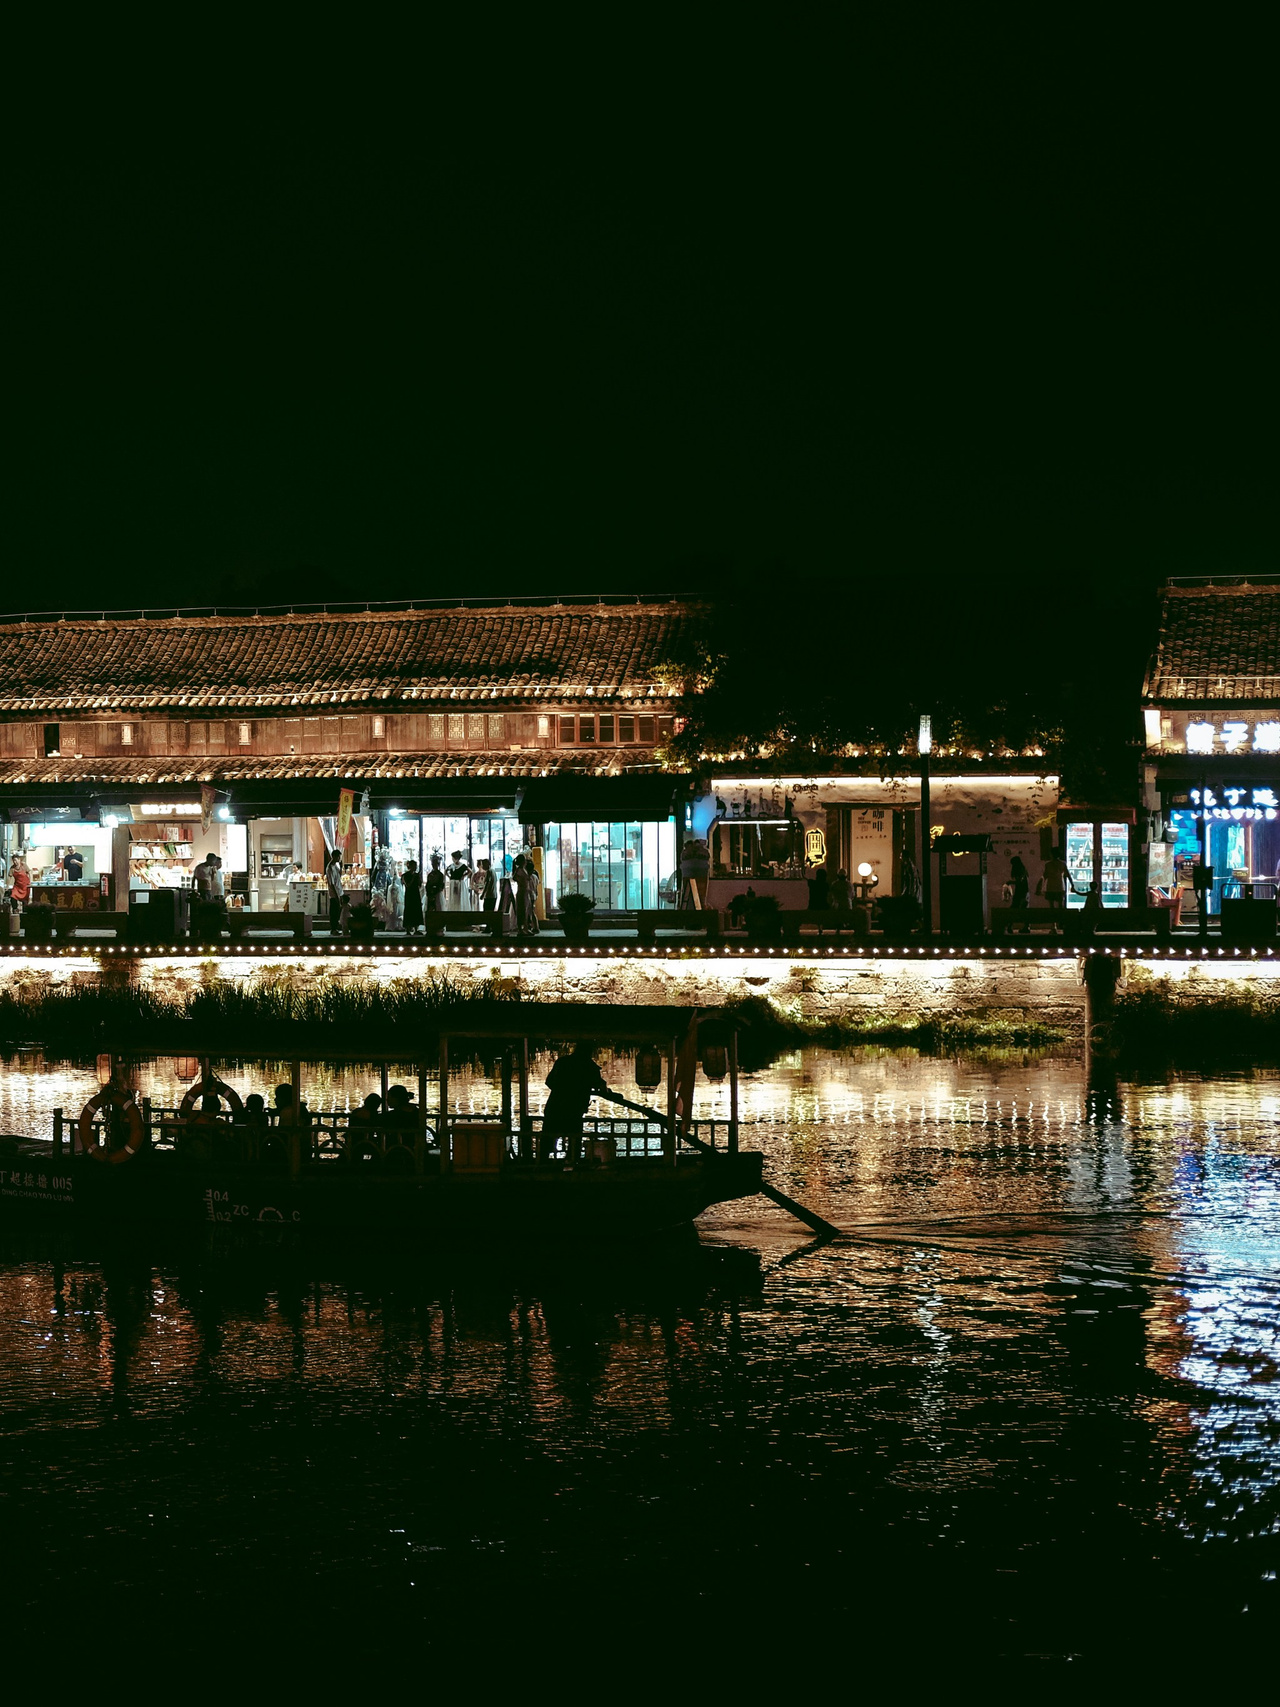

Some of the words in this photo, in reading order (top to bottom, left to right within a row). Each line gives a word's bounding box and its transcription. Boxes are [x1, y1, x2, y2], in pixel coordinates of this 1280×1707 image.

[52, 1175, 73, 1191] 005
[213, 1190, 229, 1202] 0.4
[232, 1204, 250, 1216] ZC
